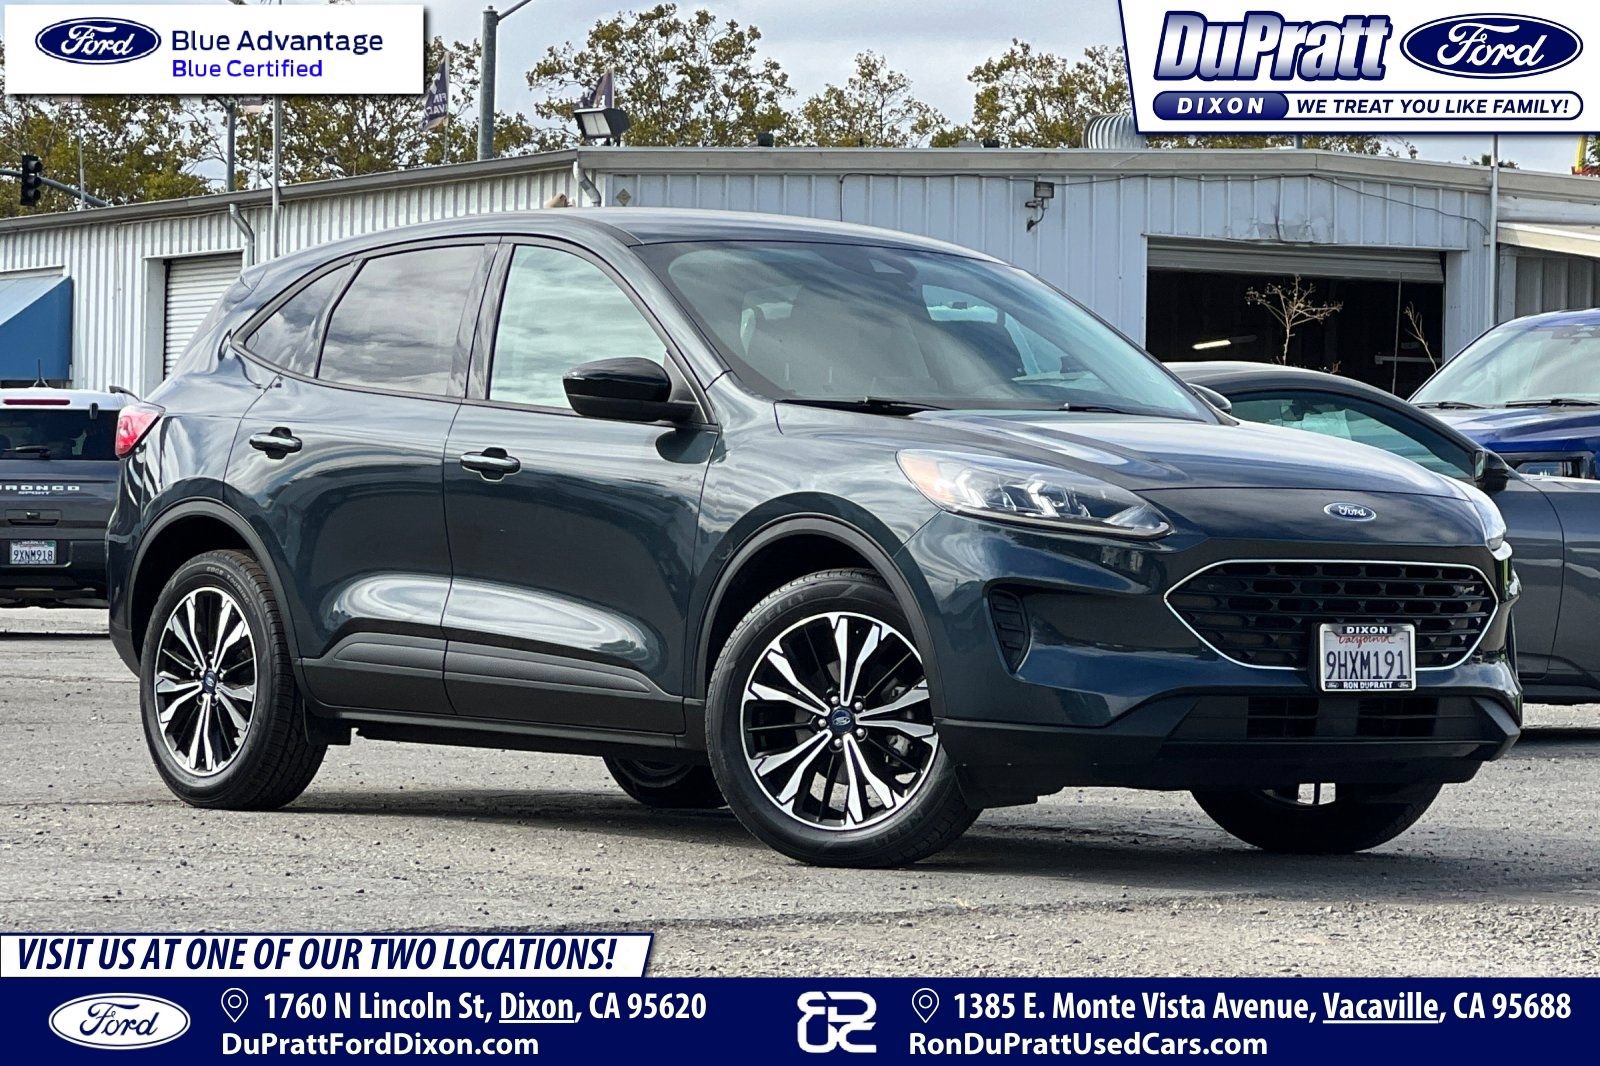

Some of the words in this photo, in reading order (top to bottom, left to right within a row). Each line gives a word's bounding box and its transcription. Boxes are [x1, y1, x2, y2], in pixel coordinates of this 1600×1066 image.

[13, 550, 53, 562] 9XNM918
[1346, 626, 1388, 634] DIXON
[1326, 650, 1407, 680] 9HXM191
[1343, 681, 1359, 689] RON
[1360, 681, 1393, 689] DUPRATT
